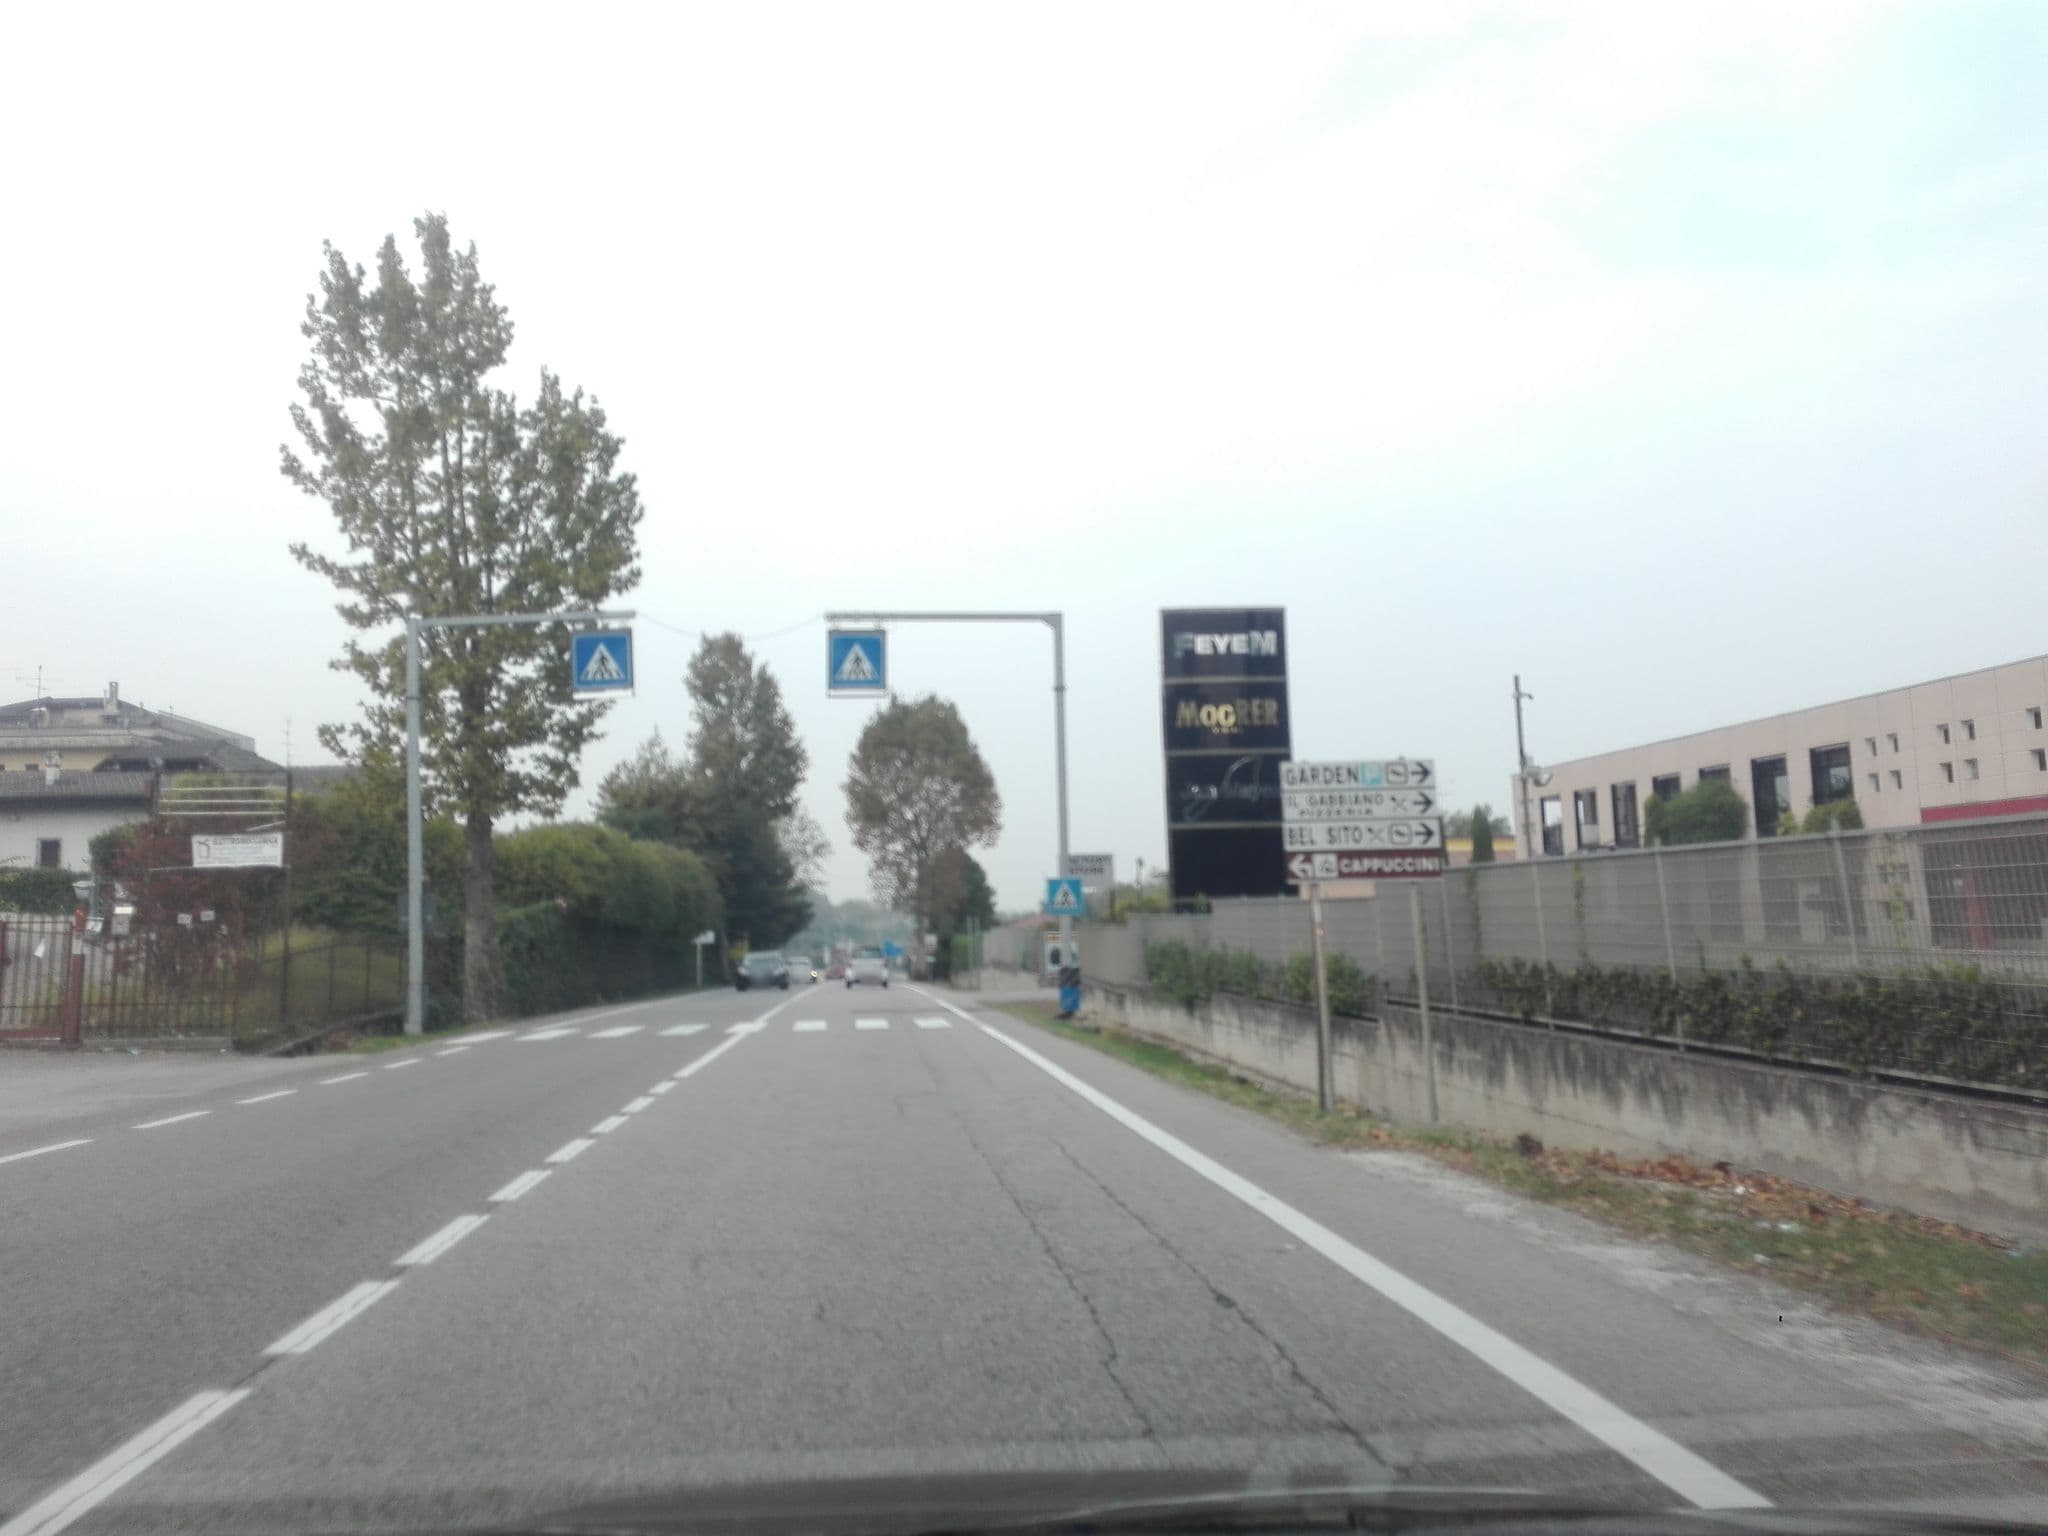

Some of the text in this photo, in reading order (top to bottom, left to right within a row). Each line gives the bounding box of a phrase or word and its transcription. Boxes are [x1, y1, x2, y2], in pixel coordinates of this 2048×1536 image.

[1286, 764, 1360, 785] GARDEN
[1308, 793, 1385, 807] GABBIANO
[1287, 825, 1363, 846] BEL SITO
[1338, 856, 1442, 874] CAPPUCCINI
